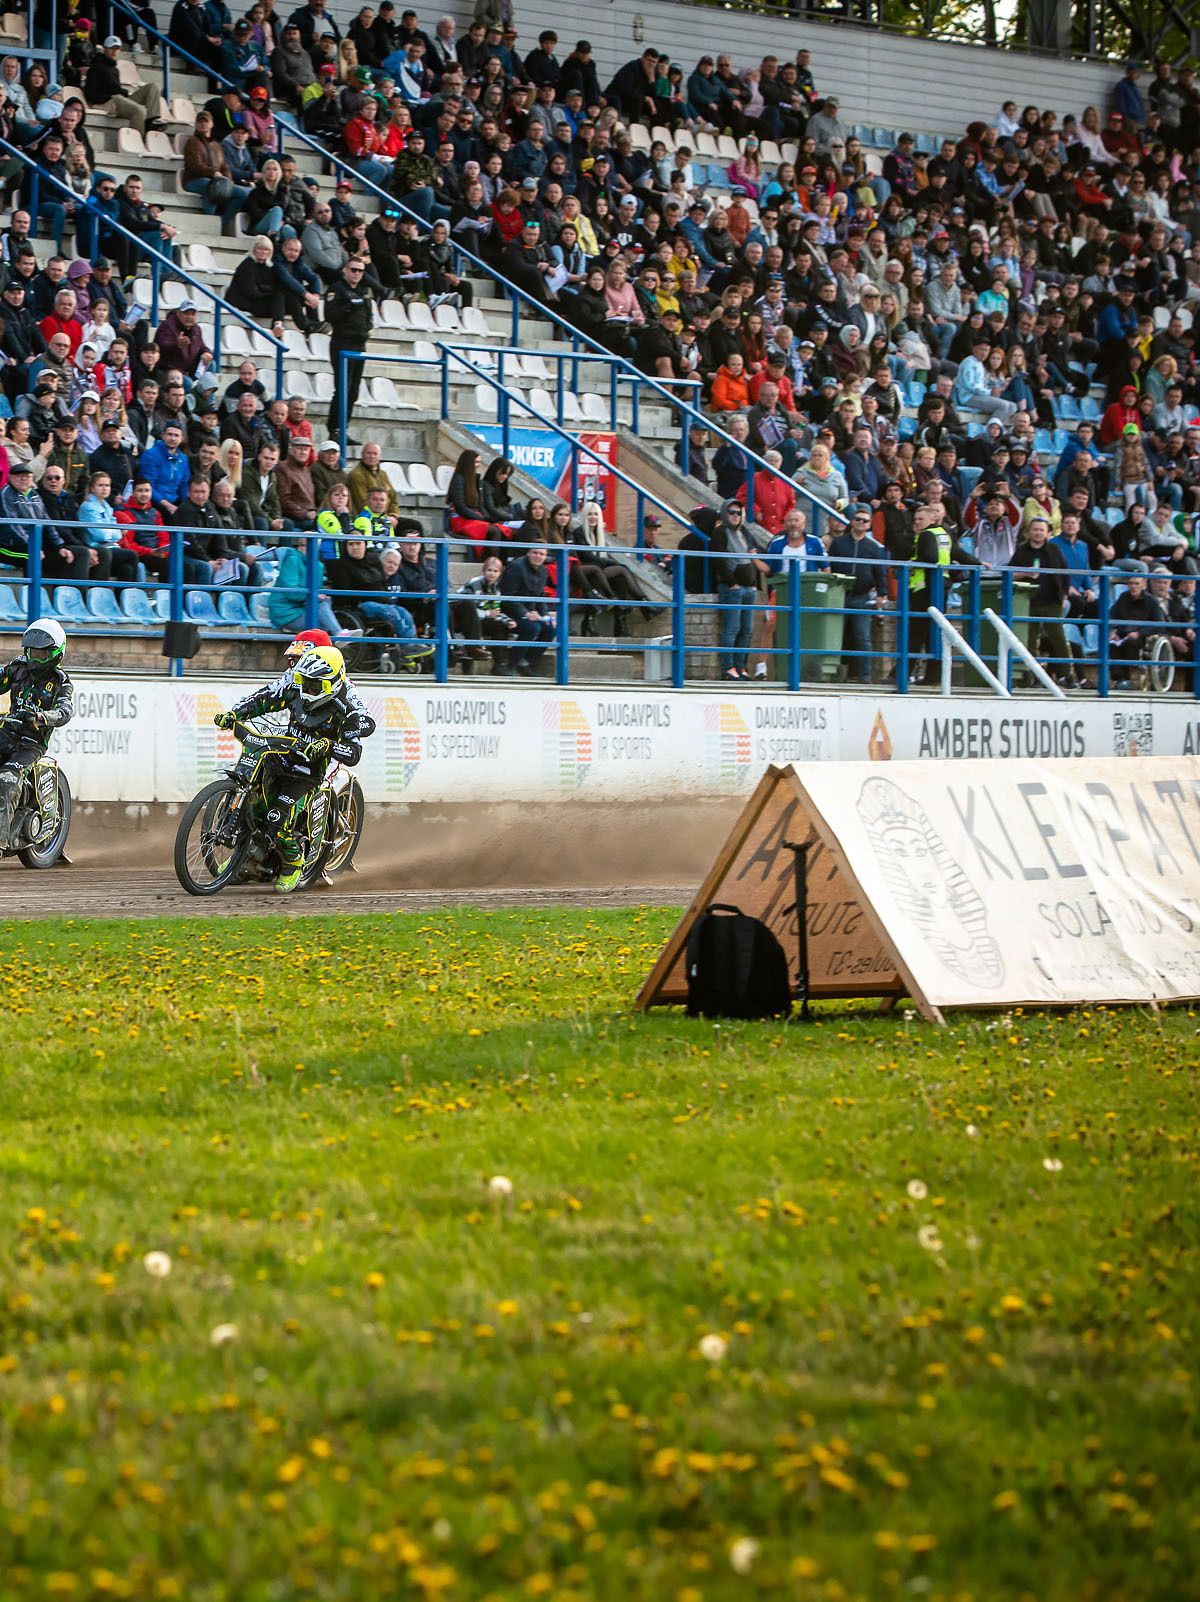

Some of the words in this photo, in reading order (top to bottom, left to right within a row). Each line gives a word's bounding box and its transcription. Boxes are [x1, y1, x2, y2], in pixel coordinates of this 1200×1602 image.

[426, 700, 506, 725] DAUGAVPILS
[597, 703, 671, 727] DAUGAVPILS
[755, 706, 826, 730] DAUGAVPILS
[65, 729, 131, 754] SPEEDWAY
[427, 734, 438, 758] IS
[441, 734, 501, 758] SPEEDWAY
[598, 736, 608, 760] IR
[611, 736, 652, 760] SPORTS
[757, 738, 767, 760] IS
[770, 738, 822, 760] SPEEDWAY
[919, 717, 992, 758] AMBER
[999, 718, 1085, 758] STUDIOS
